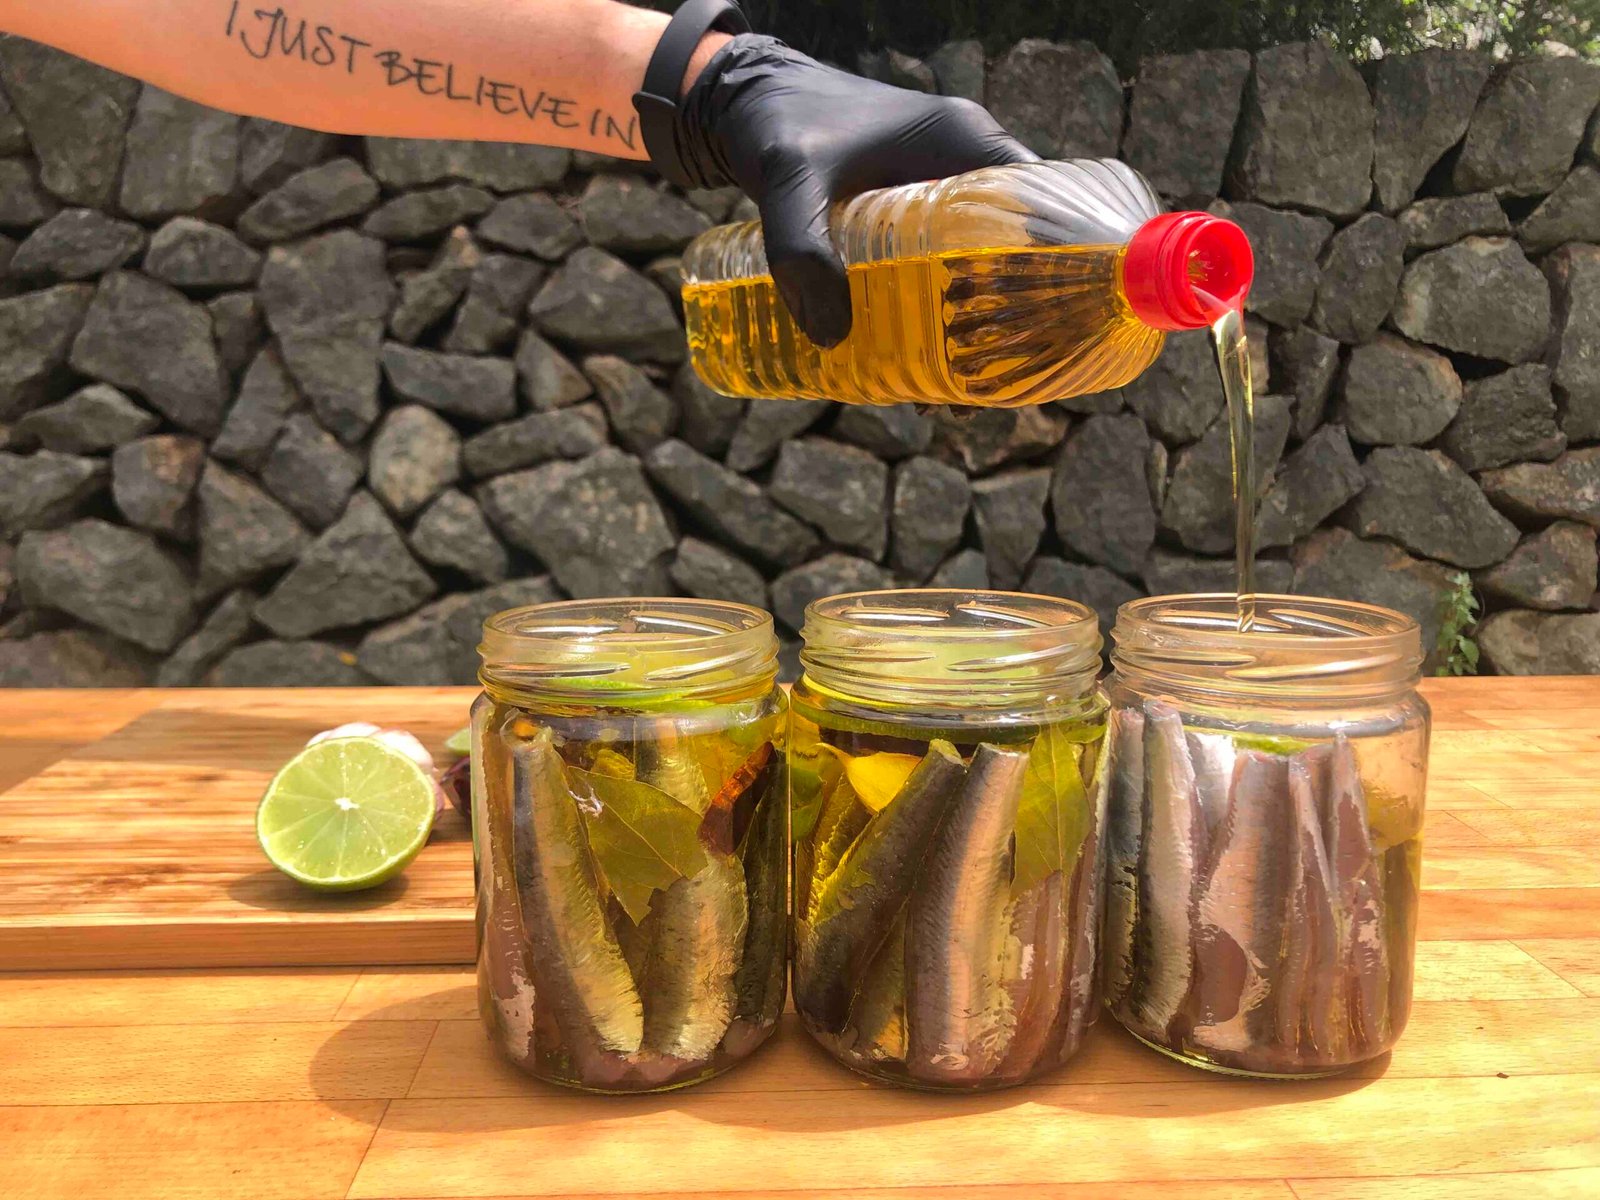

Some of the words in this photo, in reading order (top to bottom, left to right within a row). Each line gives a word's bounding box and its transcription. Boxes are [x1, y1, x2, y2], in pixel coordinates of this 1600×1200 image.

[226, 0, 239, 36] I
[240, 7, 372, 74] JUST
[374, 50, 581, 129] BELIEVE
[589, 109, 637, 151] IN
